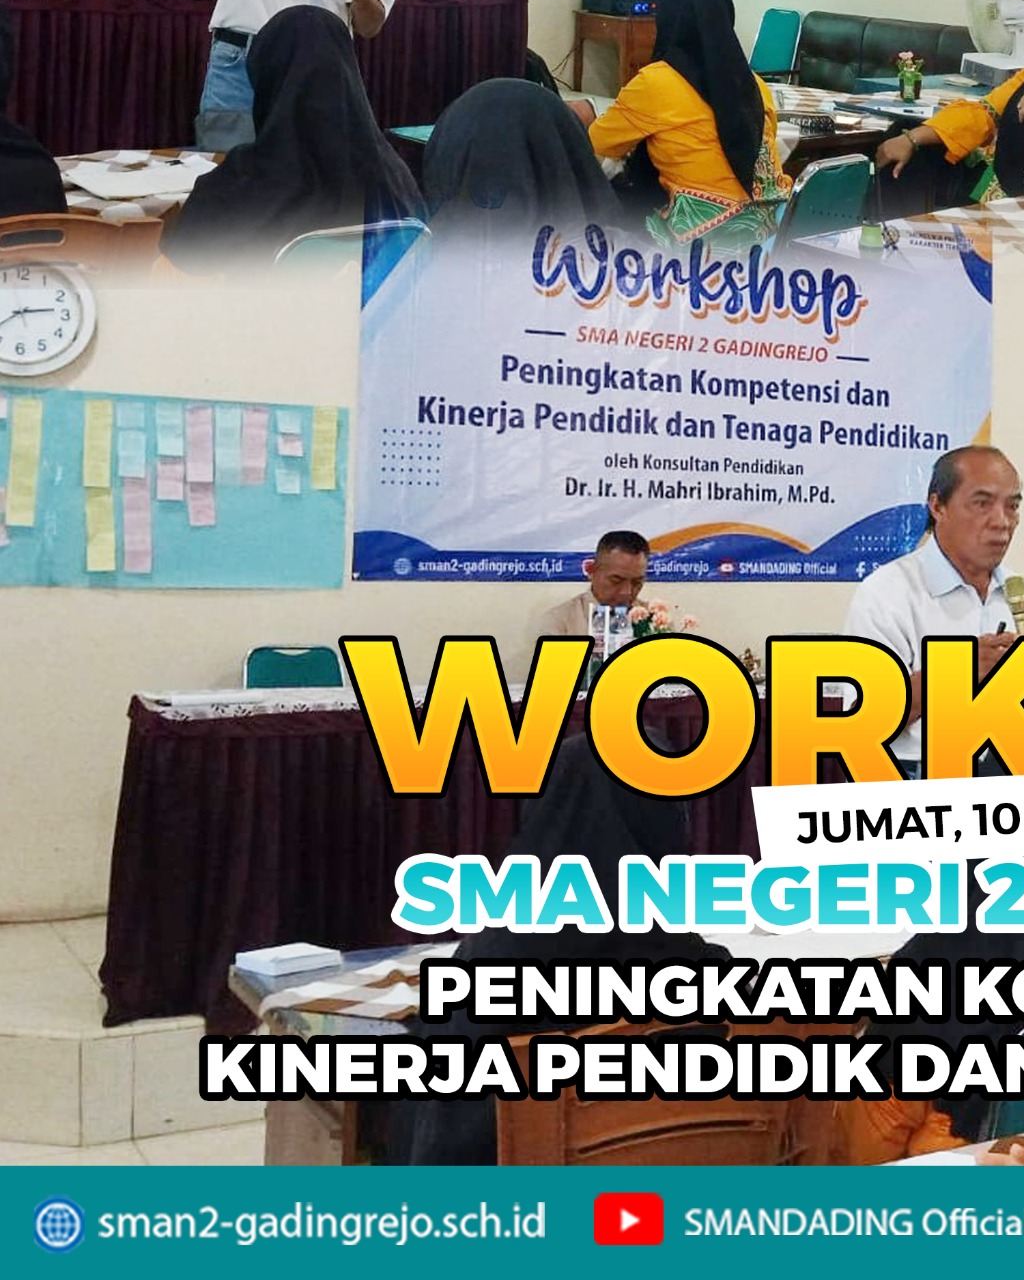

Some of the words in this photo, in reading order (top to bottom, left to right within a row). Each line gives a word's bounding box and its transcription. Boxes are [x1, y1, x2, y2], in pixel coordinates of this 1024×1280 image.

[17, 267, 30, 281] 12
[532, 224, 866, 339] Workshop
[55, 290, 65, 302] 2
[60, 309, 70, 321] 3
[54, 328, 62, 338] 4
[15, 342, 25, 355] 6
[37, 339, 46, 351] 5
[577, 326, 619, 345] SMA
[625, 328, 693, 352] NEGERI
[698, 338, 709, 352] 2
[714, 338, 829, 363] GADINGREJO
[501, 354, 682, 394] Peningkatan
[691, 369, 840, 405] Kompetensi
[847, 381, 890, 407] dan
[418, 395, 525, 434] Kinerja
[535, 402, 658, 435] Pendidik
[666, 411, 715, 439] dan
[723, 414, 812, 449] Tenaga
[820, 420, 949, 451] Pendidikan
[604, 453, 638, 469] oleh
[643, 454, 719, 472] Konsultan
[724, 457, 804, 475] Pendidikan
[566, 477, 592, 496] Dr.
[599, 478, 617, 497] Ir.
[624, 479, 642, 498] H.
[648, 480, 701, 500] Mahri
[708, 482, 783, 505] Ibrahim,
[788, 485, 835, 504] M.Pd.
